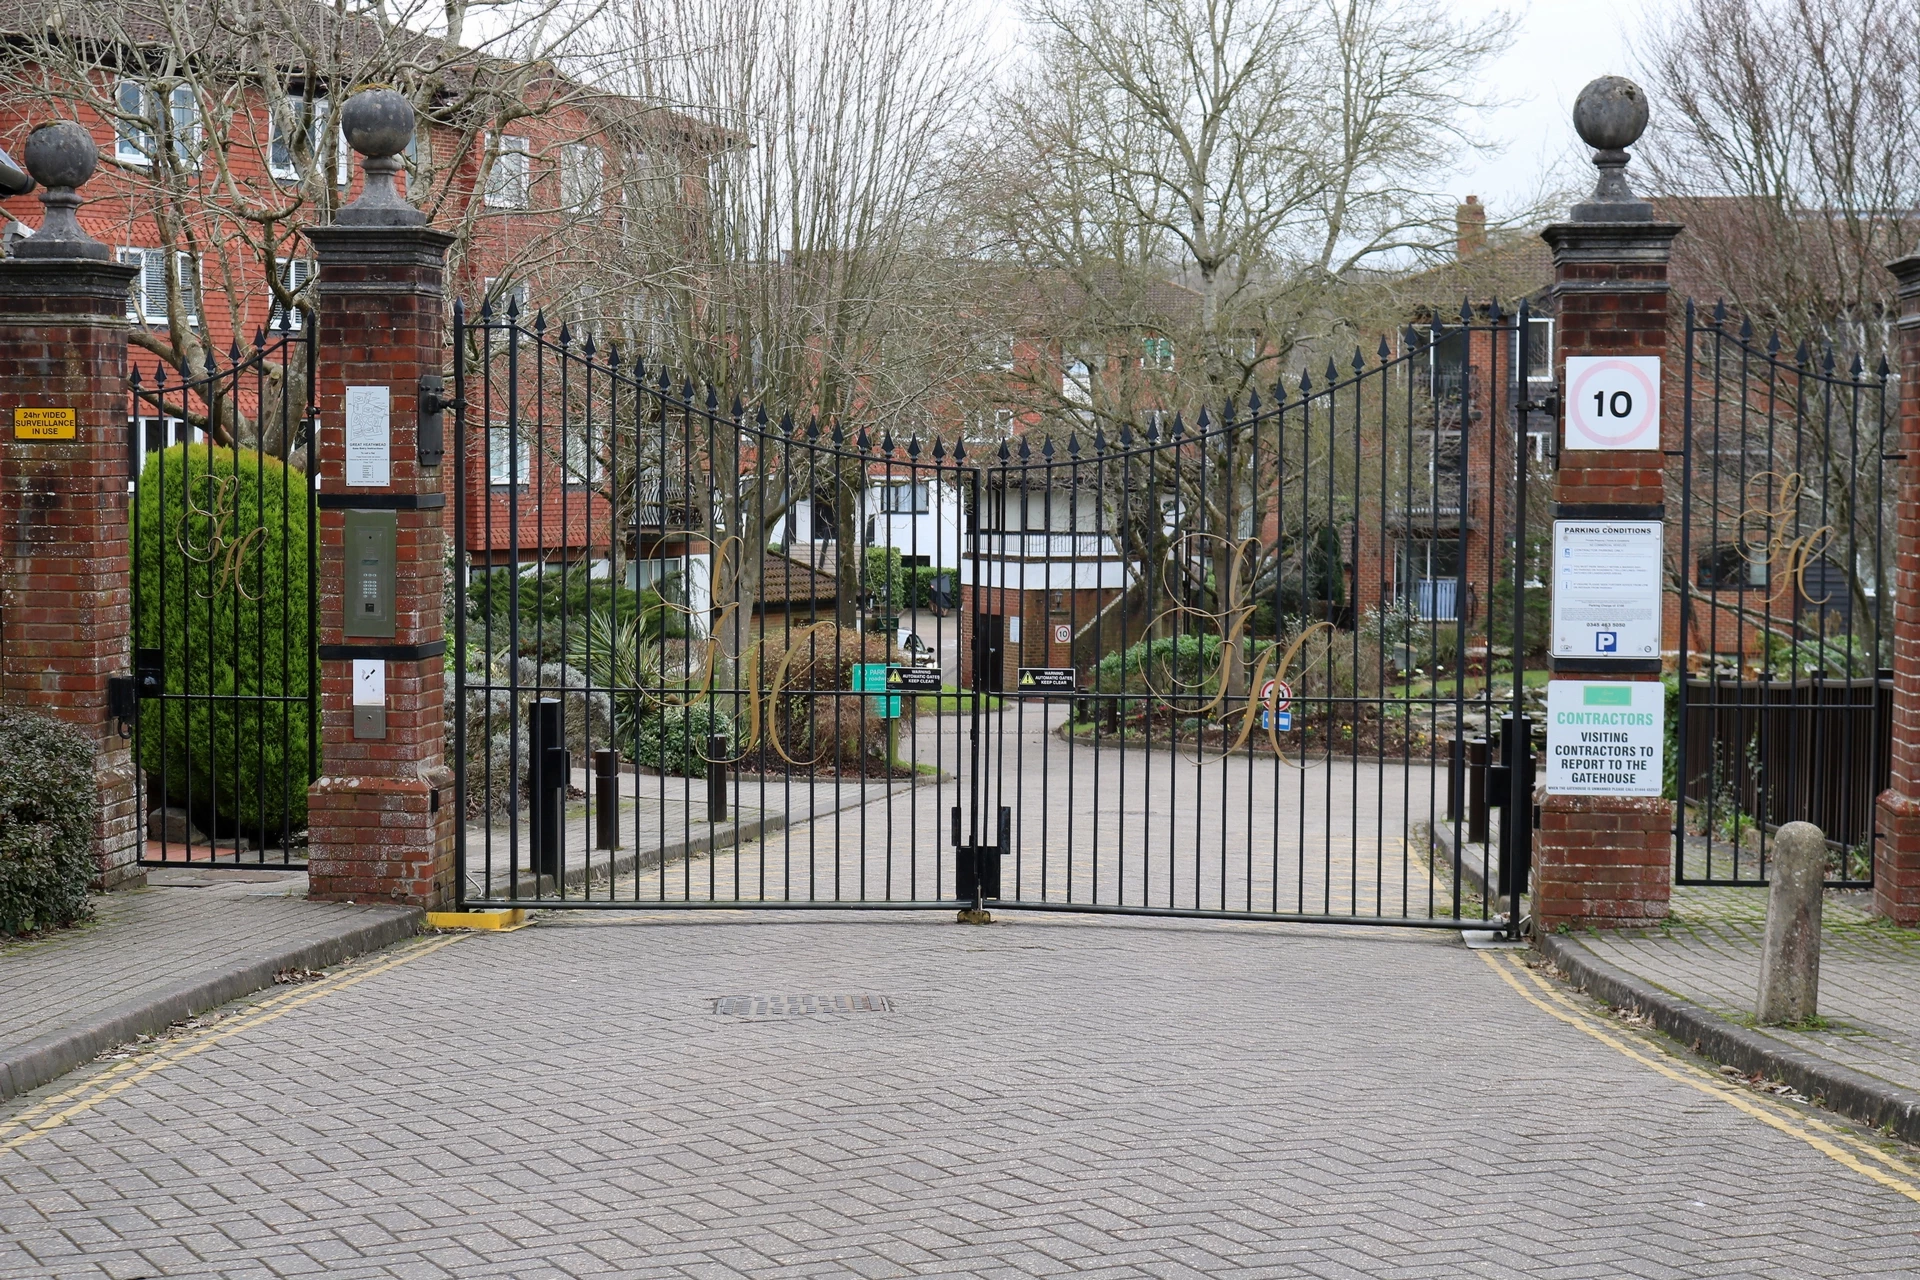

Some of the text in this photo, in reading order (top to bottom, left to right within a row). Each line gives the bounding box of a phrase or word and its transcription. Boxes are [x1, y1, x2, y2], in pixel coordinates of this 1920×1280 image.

[1594, 390, 1632, 418] 10
[1557, 712, 1653, 726] CONTRACTORS
[1581, 732, 1628, 743] VISITING
[1555, 745, 1654, 757] CONTRACTORS TO
[1561, 759, 1647, 770] REPORT TO THE
[1572, 772, 1636, 784] GATEHOUSE
